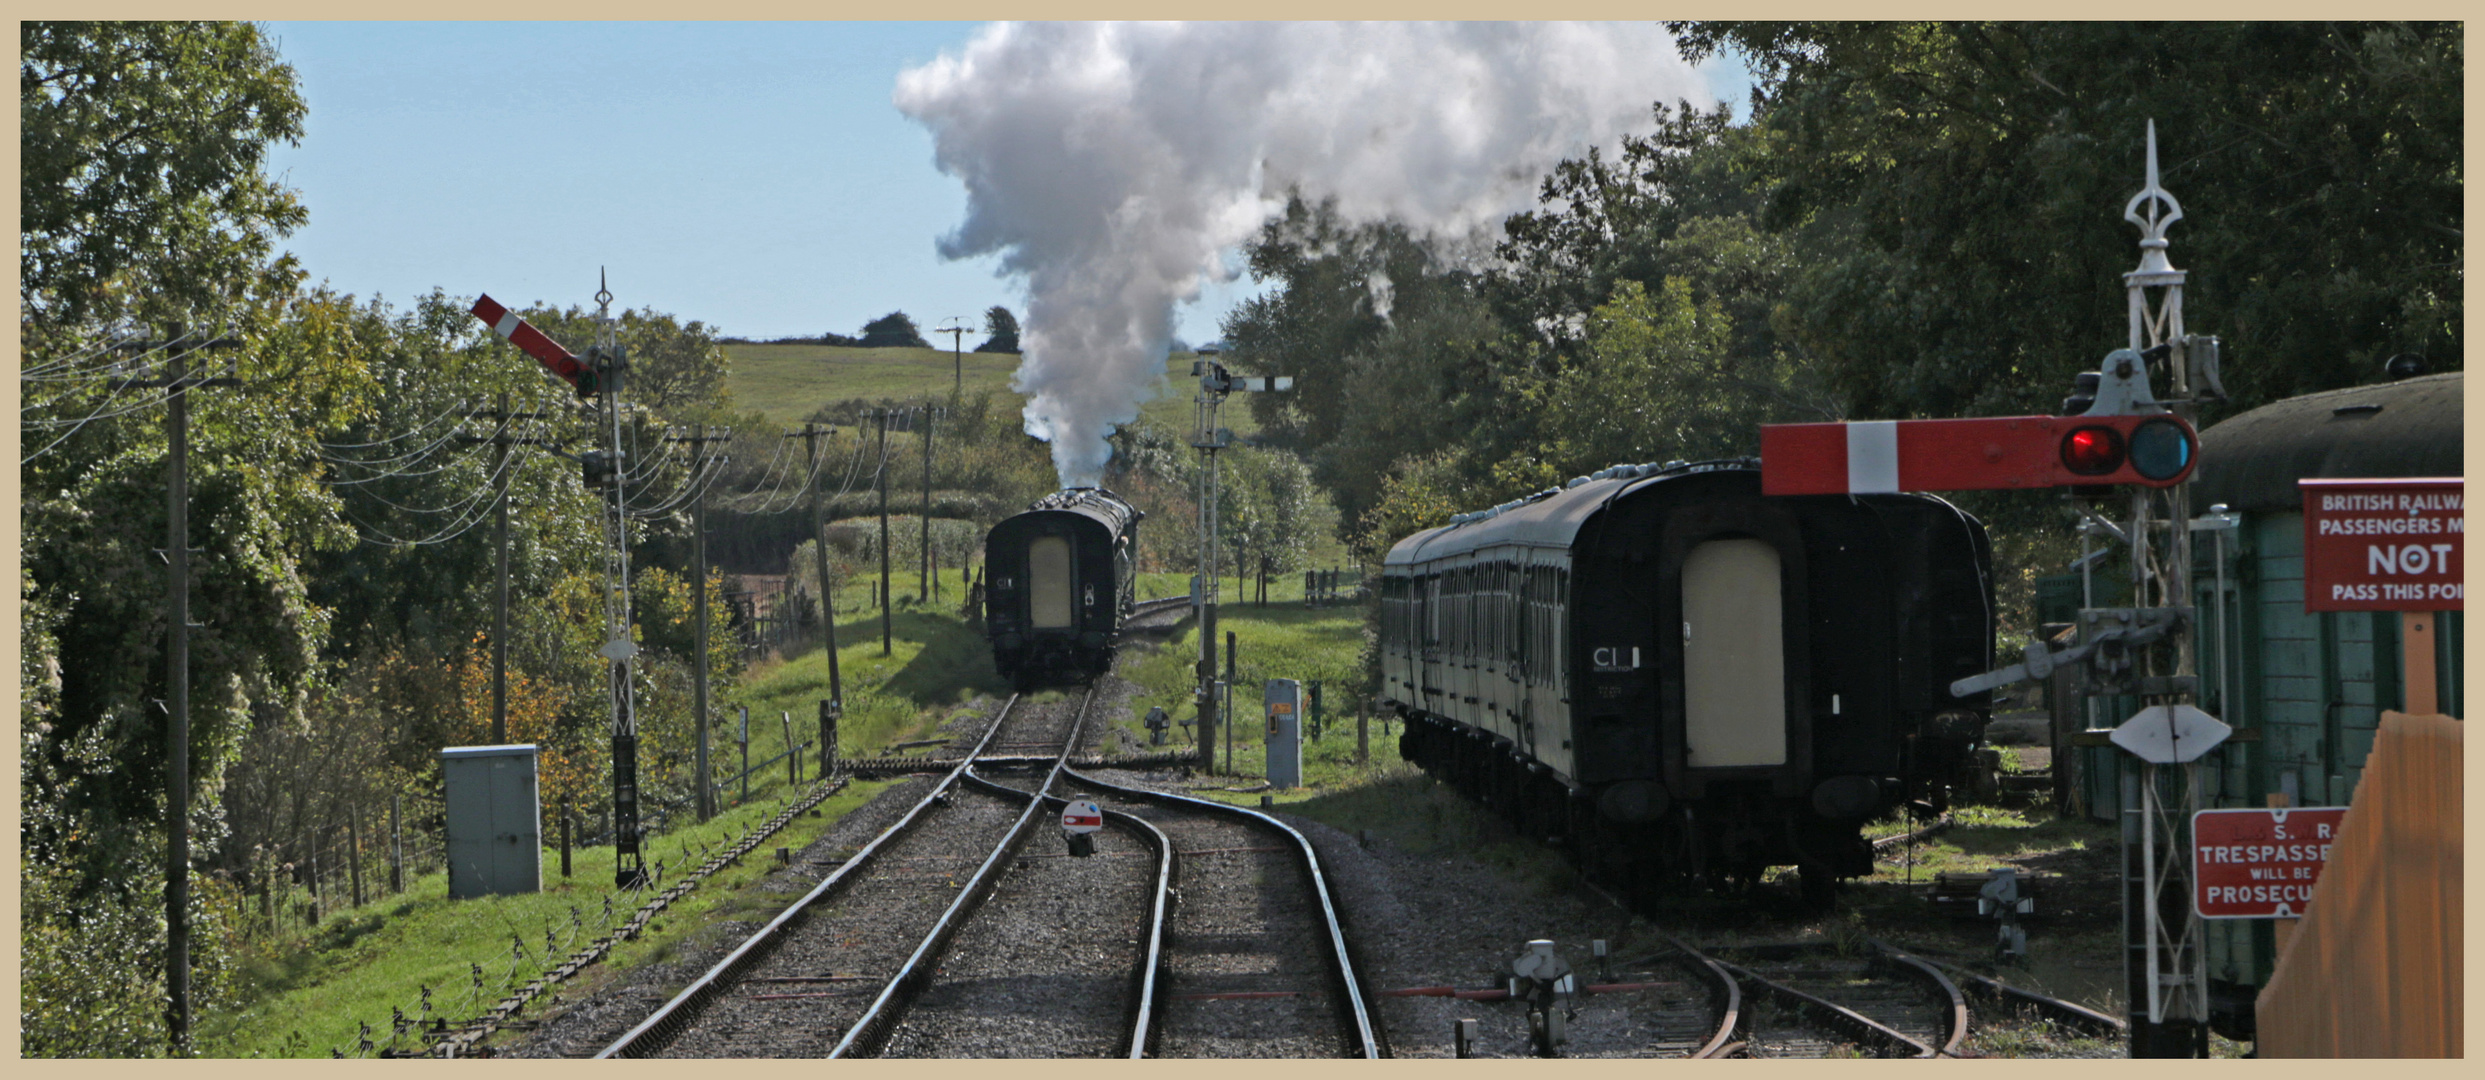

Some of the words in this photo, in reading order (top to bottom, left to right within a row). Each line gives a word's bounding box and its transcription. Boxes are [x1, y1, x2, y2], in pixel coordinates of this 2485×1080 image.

[2322, 495, 2394, 511] BRITISH
[2399, 494, 2464, 510] RAILW
[2319, 518, 2442, 535] PASSENGERS
[2368, 544, 2453, 575] NOT
[2332, 584, 2378, 600] PASS
[2383, 584, 2424, 599] THIS
[2428, 583, 2464, 599] POI
[2273, 825, 2295, 840] S.
[2250, 868, 2287, 880] WILL
[2294, 867, 2312, 879] BE
[2207, 885, 2312, 904] PROSECU
